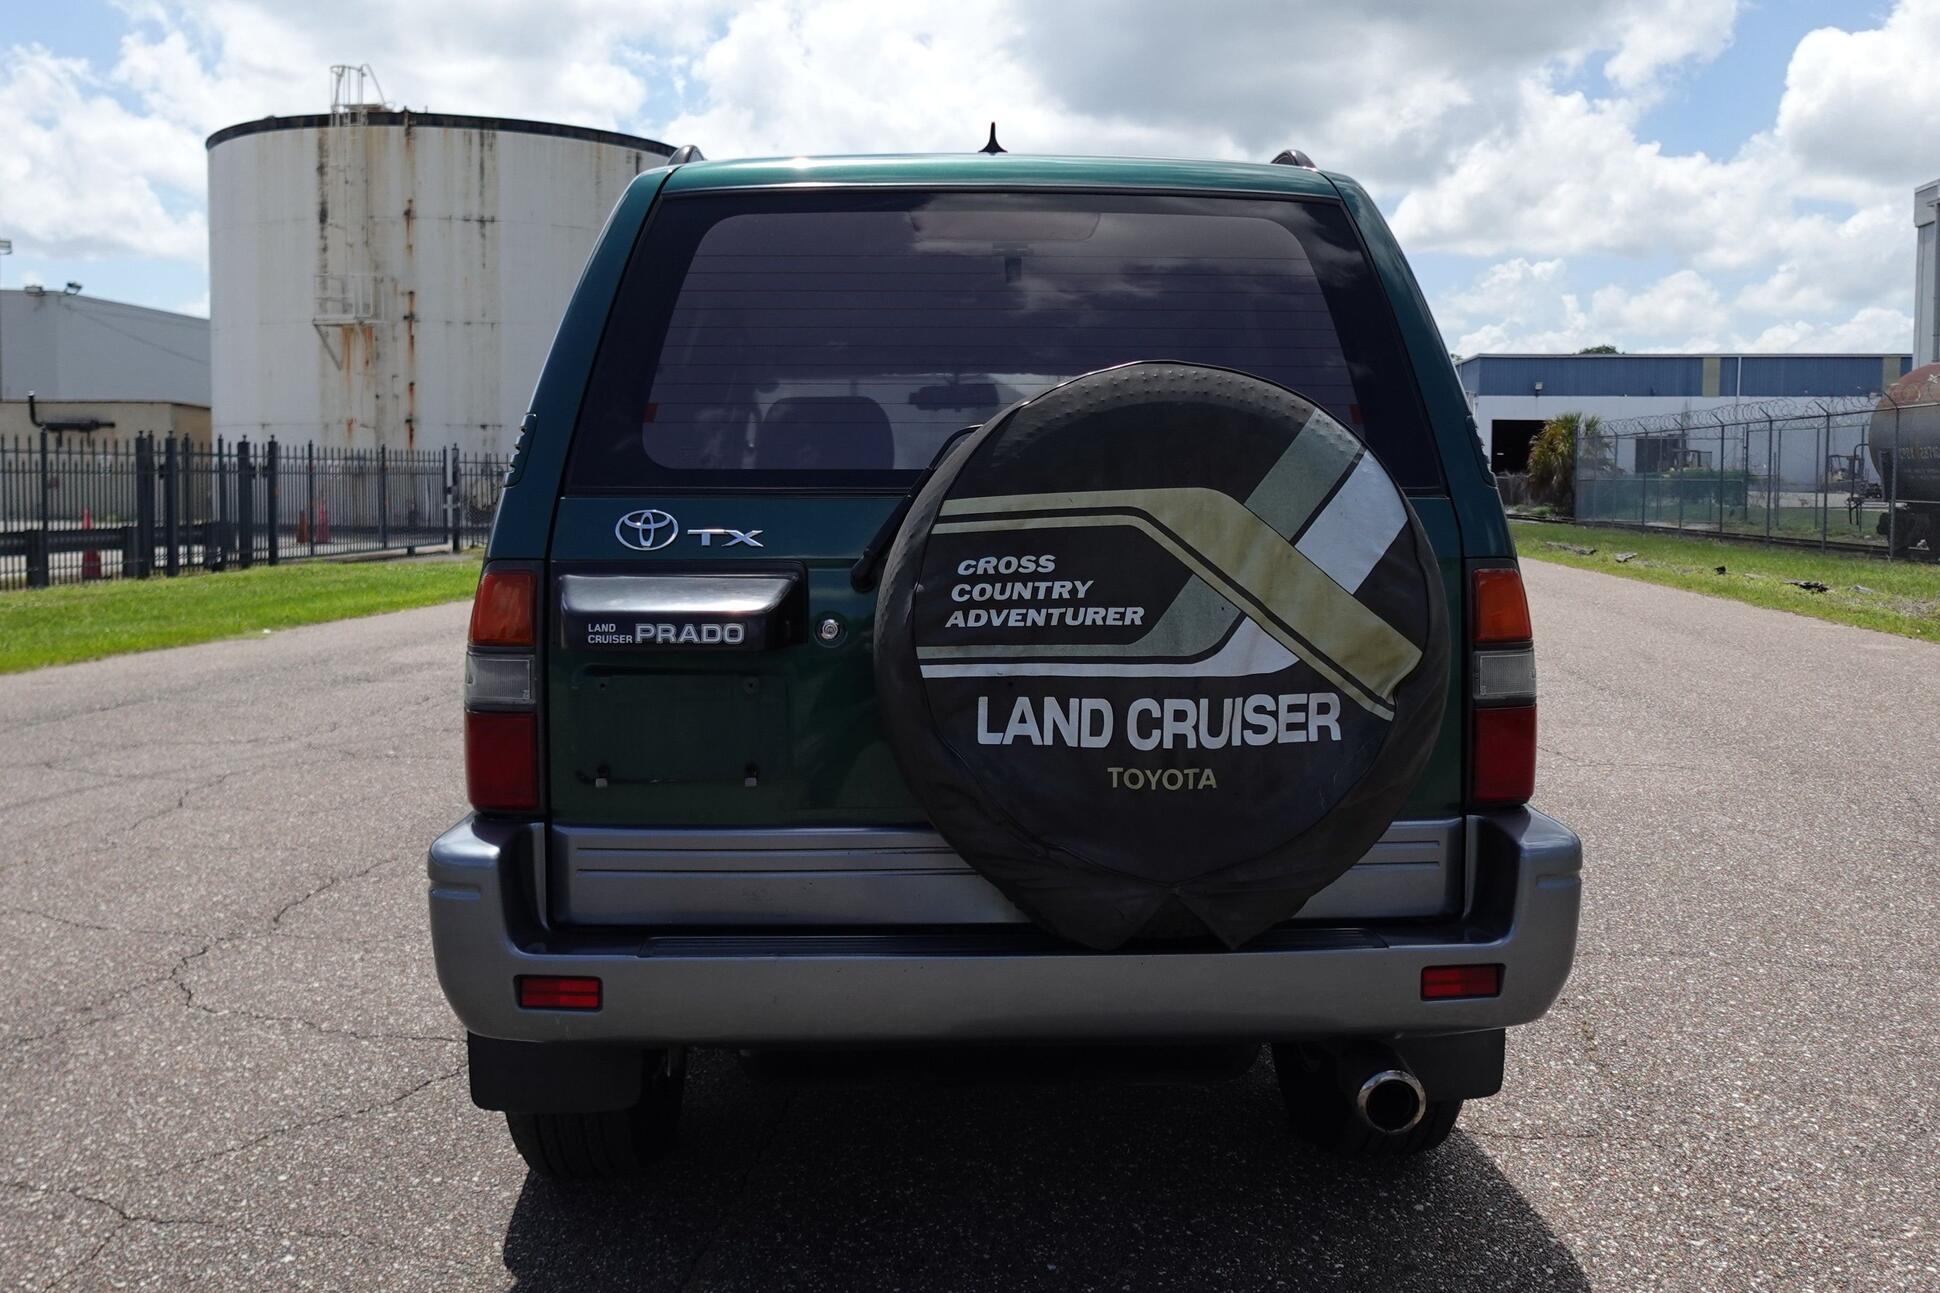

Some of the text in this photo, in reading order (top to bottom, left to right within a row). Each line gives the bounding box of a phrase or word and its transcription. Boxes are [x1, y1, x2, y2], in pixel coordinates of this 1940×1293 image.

[687, 529, 764, 547] TX
[957, 555, 1056, 575] CROSS
[951, 580, 1094, 602] COUNTRY
[588, 623, 617, 633] LAND
[945, 607, 1145, 628] ADVENTURER
[587, 634, 633, 644] CRUISER
[635, 623, 745, 644] PRADO
[977, 692, 1342, 751] LAND CRUISER
[1107, 767, 1217, 791] TOYOTA
